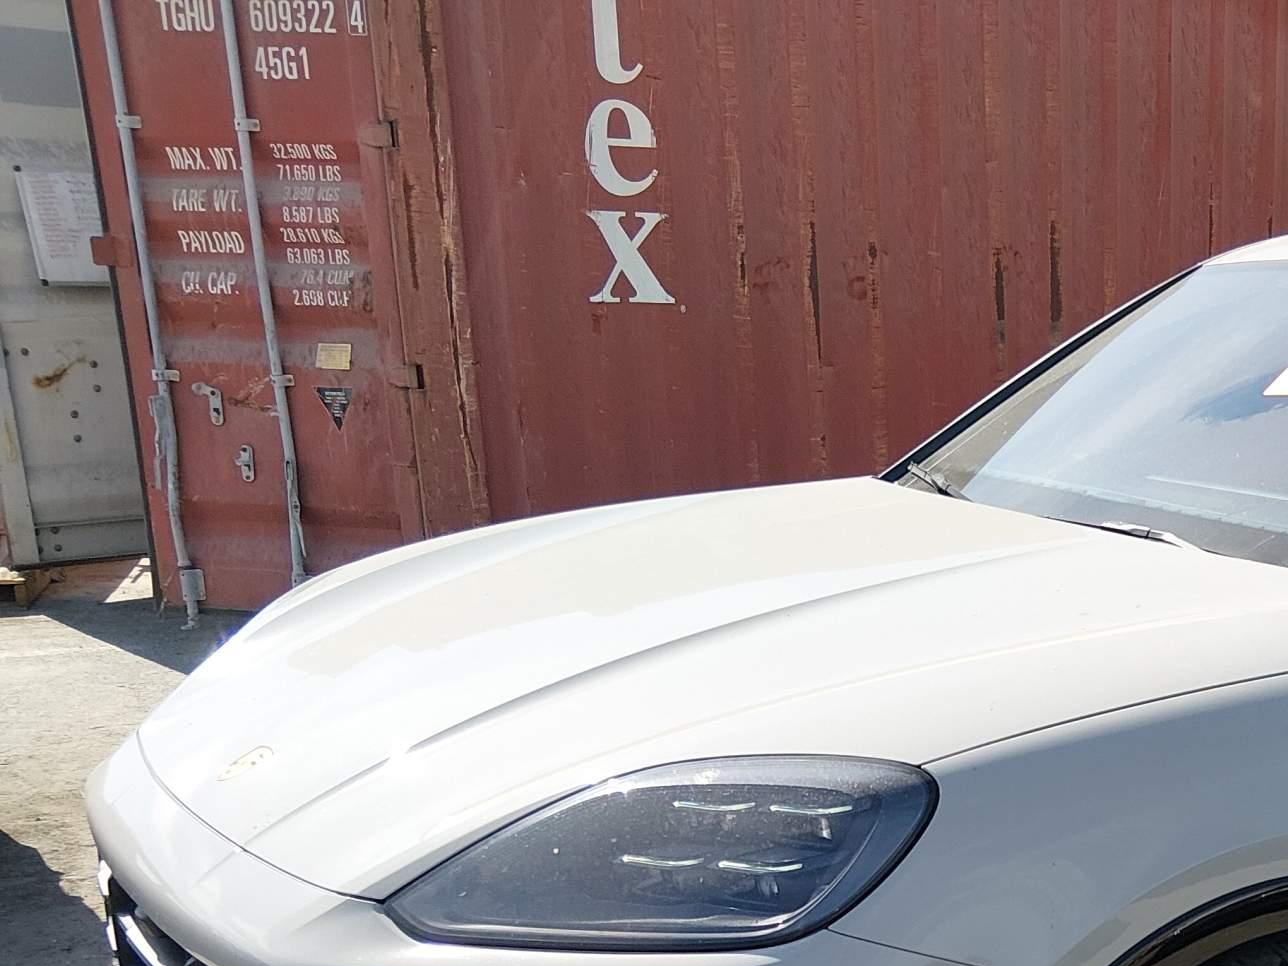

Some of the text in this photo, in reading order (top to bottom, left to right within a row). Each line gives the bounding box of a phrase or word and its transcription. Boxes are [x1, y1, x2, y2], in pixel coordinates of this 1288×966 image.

[157, 0, 364, 33] TGHU 609322 4
[254, 46, 310, 80] 45G1
[165, 146, 243, 170] MAX. WT.
[269, 143, 337, 160] 32.500 KGS
[276, 164, 342, 182] 71.650 LBS
[172, 188, 242, 212] TARE WT.
[317, 186, 340, 201] KGS
[282, 206, 339, 224] 8.587 LBS
[177, 230, 245, 254] PAYLOAD
[280, 227, 345, 244] 28.610 KGS
[286, 247, 350, 265] 63.063 LBS
[207, 272, 240, 295] CAP.
[293, 289, 325, 306] 2.698
